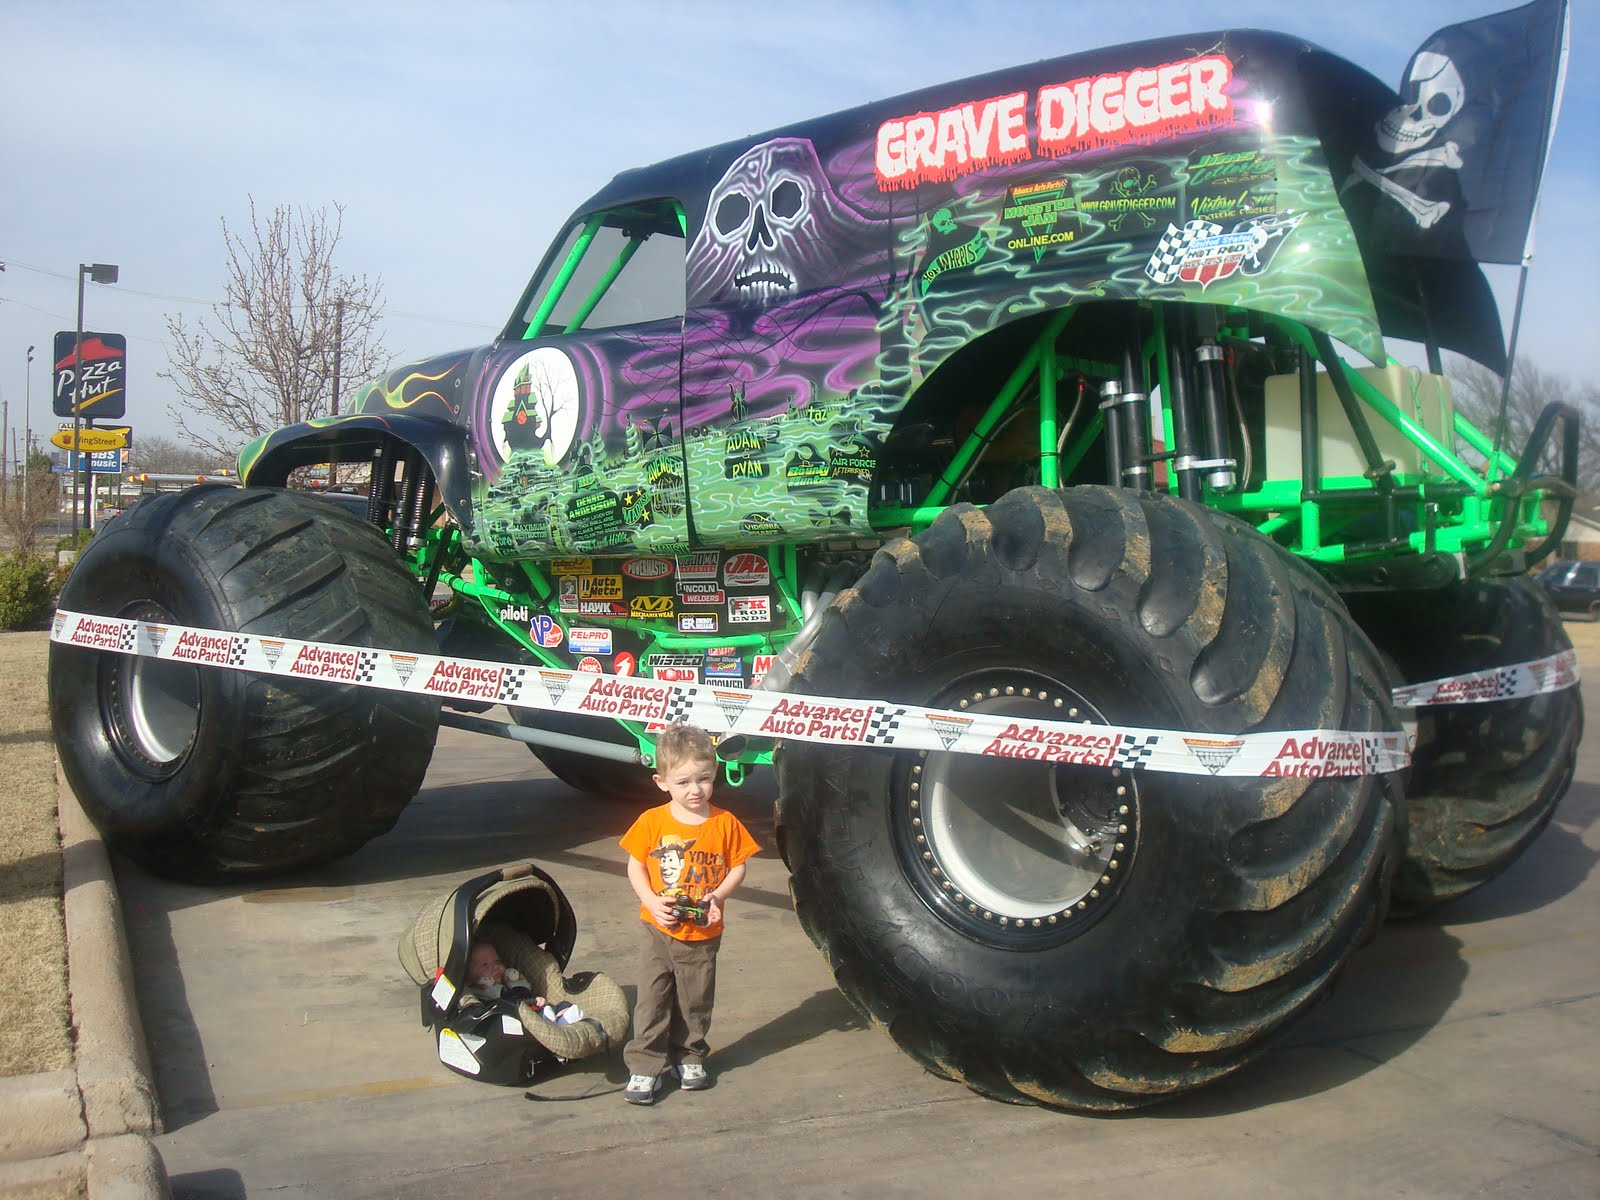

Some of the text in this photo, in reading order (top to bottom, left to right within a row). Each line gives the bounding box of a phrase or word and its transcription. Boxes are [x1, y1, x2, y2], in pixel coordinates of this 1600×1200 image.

[875, 56, 1233, 183] GRAVE DIGGER
[1004, 198, 1075, 219] MONSTER
[1022, 211, 1058, 227] JAM
[1008, 231, 1074, 249] ONLINE.COM
[57, 361, 122, 397] Pzza
[78, 436, 116, 446] ingStreet
[726, 432, 761, 453] ADAM
[732, 460, 763, 479] RYAN
[831, 458, 876, 468] AIR FORCE
[569, 498, 617, 519] ANDERSON
[576, 491, 605, 507] DENNIS
[725, 554, 769, 574] JAZ
[590, 586, 621, 596] Meter
[591, 578, 616, 587] Auto
[679, 584, 715, 593] INCOLN
[581, 602, 612, 613] HAWK
[687, 594, 720, 602] WELDERS
[500, 604, 528, 622] piloti
[76, 617, 120, 637] Advance
[530, 615, 553, 646] VP
[70, 632, 117, 648] Auto Parts
[178, 631, 228, 651] Advance
[172, 645, 226, 664] Auto Parts
[297, 645, 354, 666] Advance
[289, 661, 352, 680] Auto Parts
[432, 660, 497, 683] Advance
[582, 663, 598, 673] NGK
[424, 677, 495, 698] Auto Parts
[588, 677, 664, 702] Advance
[578, 696, 661, 719] Auto Parts
[771, 699, 863, 723] Advance
[759, 717, 859, 742] Auto Parts
[996, 723, 1112, 748] Advance
[982, 739, 1102, 766] Auto Parts
[1275, 737, 1361, 760] Advance
[1259, 761, 1361, 778] Auto Parts
[684, 865, 724, 884] MY
